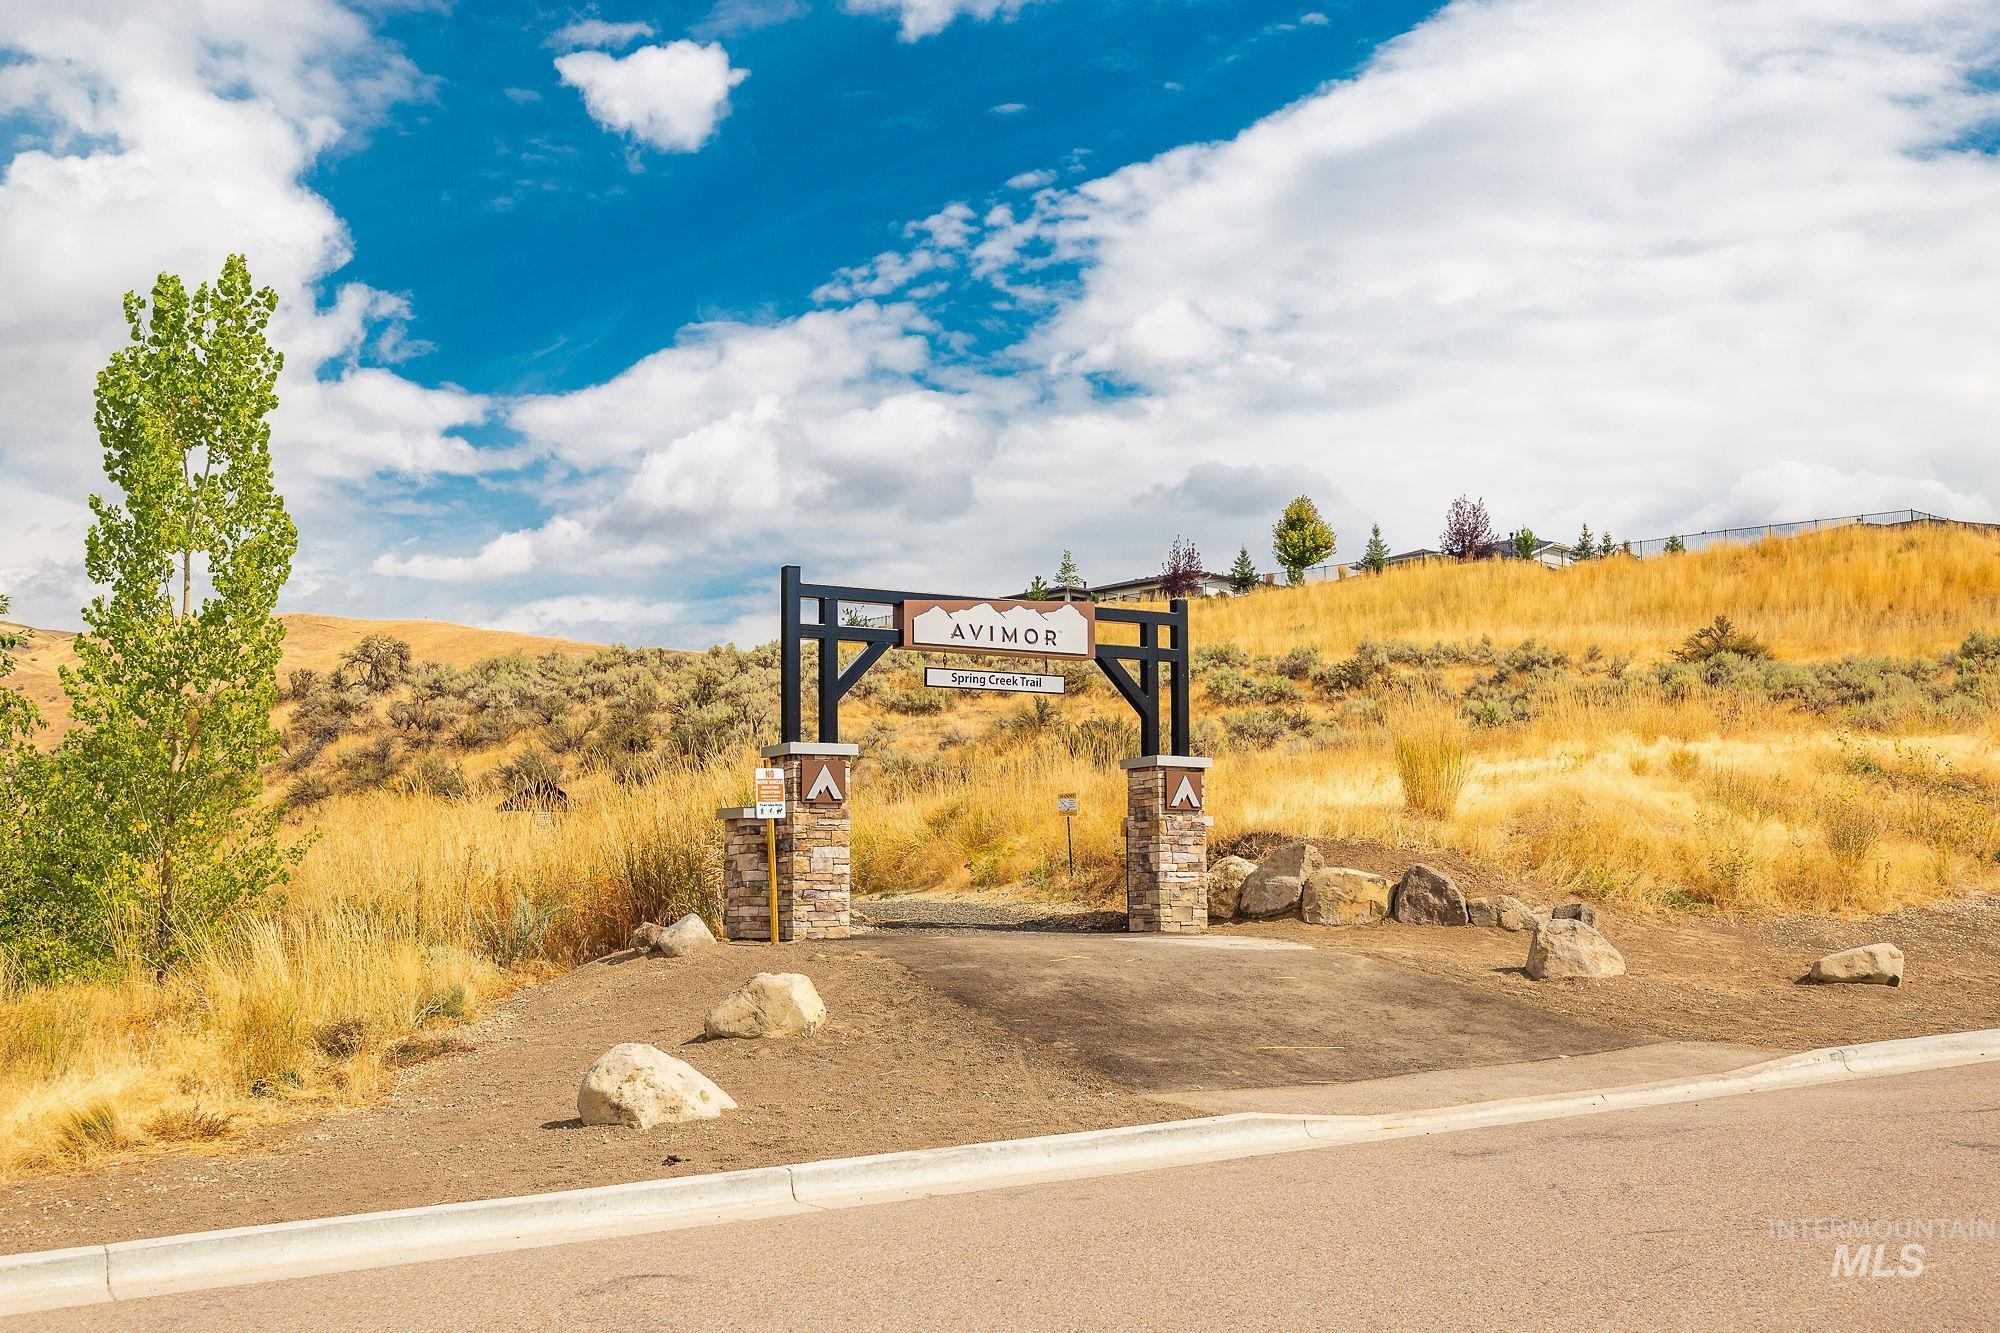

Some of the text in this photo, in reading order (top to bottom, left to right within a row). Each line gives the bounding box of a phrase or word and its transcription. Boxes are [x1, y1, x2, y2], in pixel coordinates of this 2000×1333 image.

[951, 623, 1057, 646] AVIMOR
[951, 672, 1042, 688] Spring Creek Trail
[765, 769, 774, 778] NO
